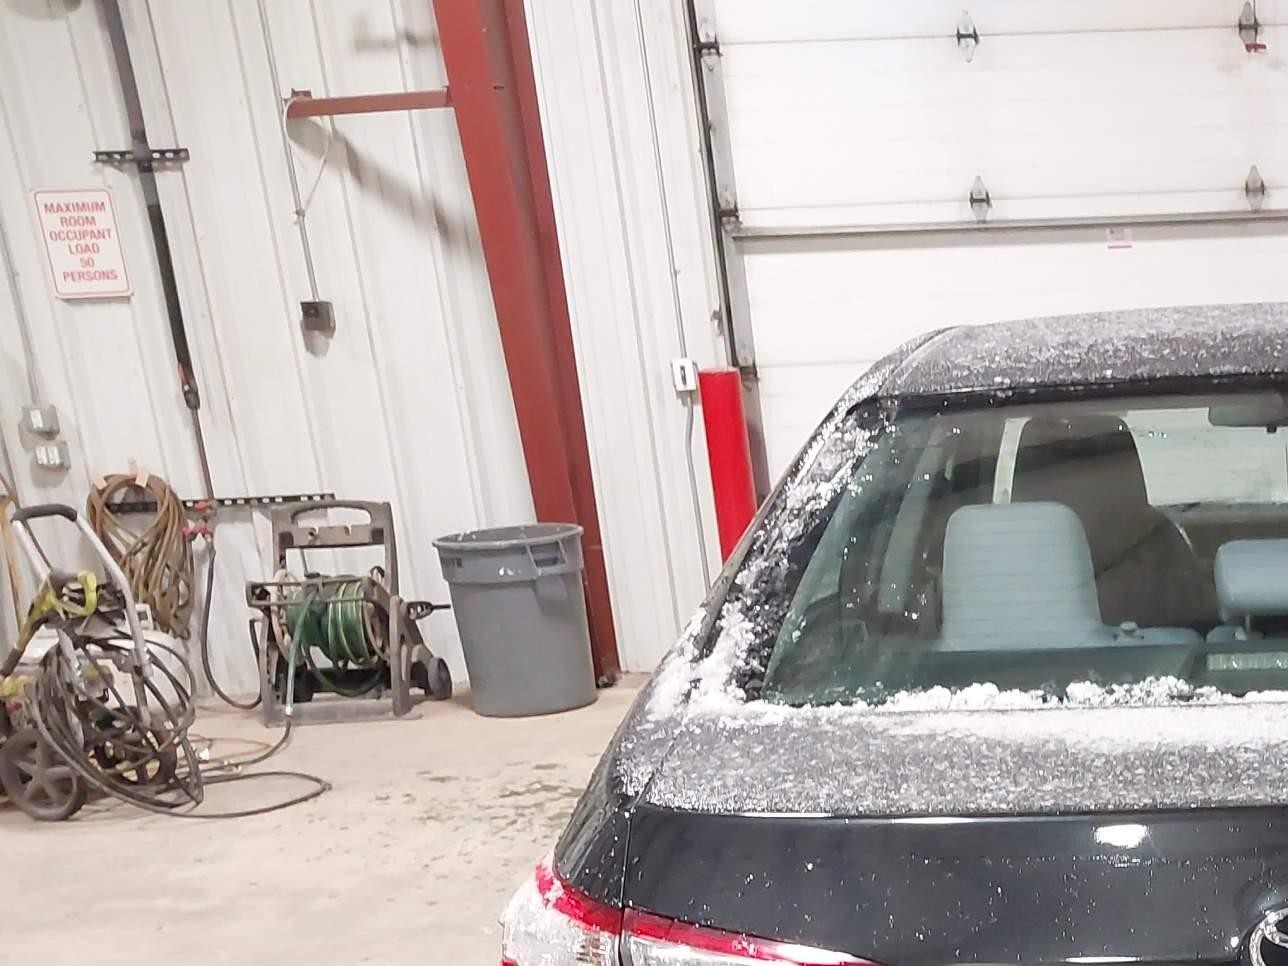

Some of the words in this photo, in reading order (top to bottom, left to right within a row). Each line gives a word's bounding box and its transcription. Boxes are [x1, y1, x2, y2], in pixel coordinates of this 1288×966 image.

[44, 201, 106, 214] MAXIMUM
[60, 215, 97, 227] ROOM
[49, 228, 112, 241] OCCUPANT
[68, 242, 100, 255] LOAD
[80, 257, 95, 268] 50
[63, 269, 118, 282] PERSONS
